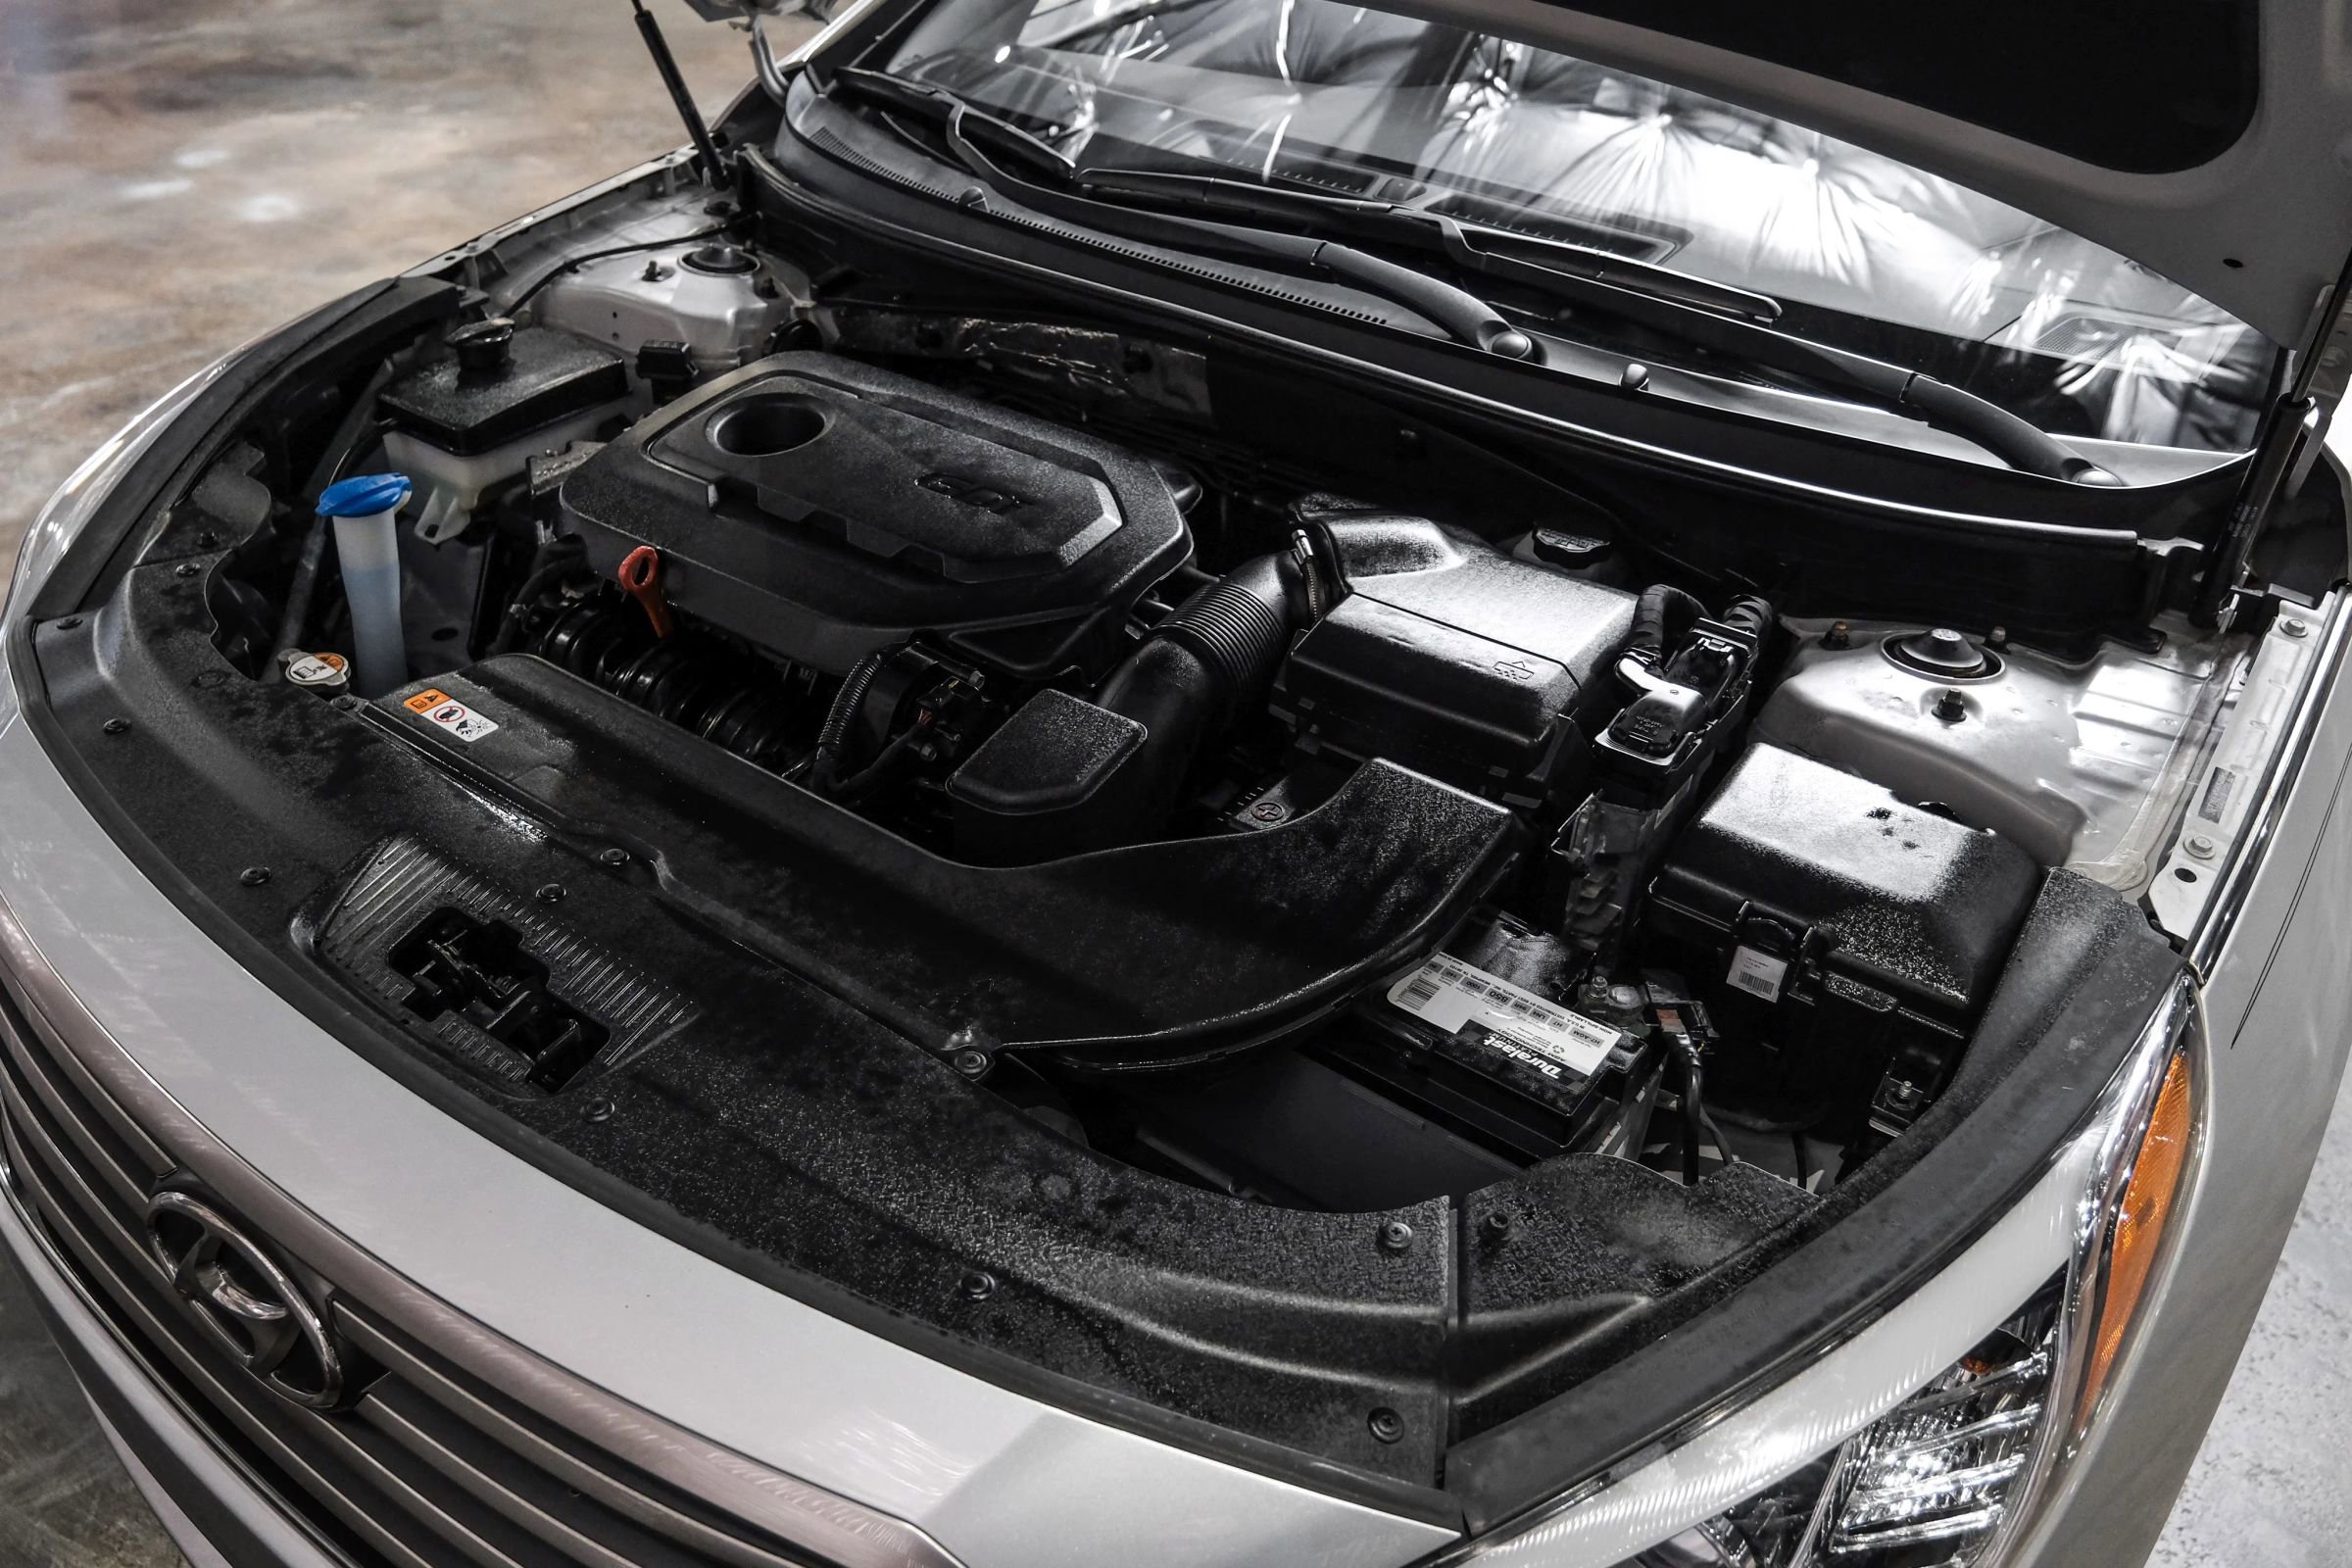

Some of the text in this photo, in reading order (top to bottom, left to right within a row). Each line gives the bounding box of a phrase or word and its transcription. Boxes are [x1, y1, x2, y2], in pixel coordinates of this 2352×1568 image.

[1465, 980, 1481, 989] 1000
[1488, 990, 1508, 1003] 850
[1568, 1013, 1612, 1034] NON-SPILLABLE
[1490, 1031, 1538, 1056] PLATINUM
[1494, 1028, 1546, 1053] TECHNOLOGY
[1571, 1030, 1600, 1044] H7-AGM
[1482, 1034, 1562, 1079] Duralast
[1545, 1052, 1566, 1061] AGM
